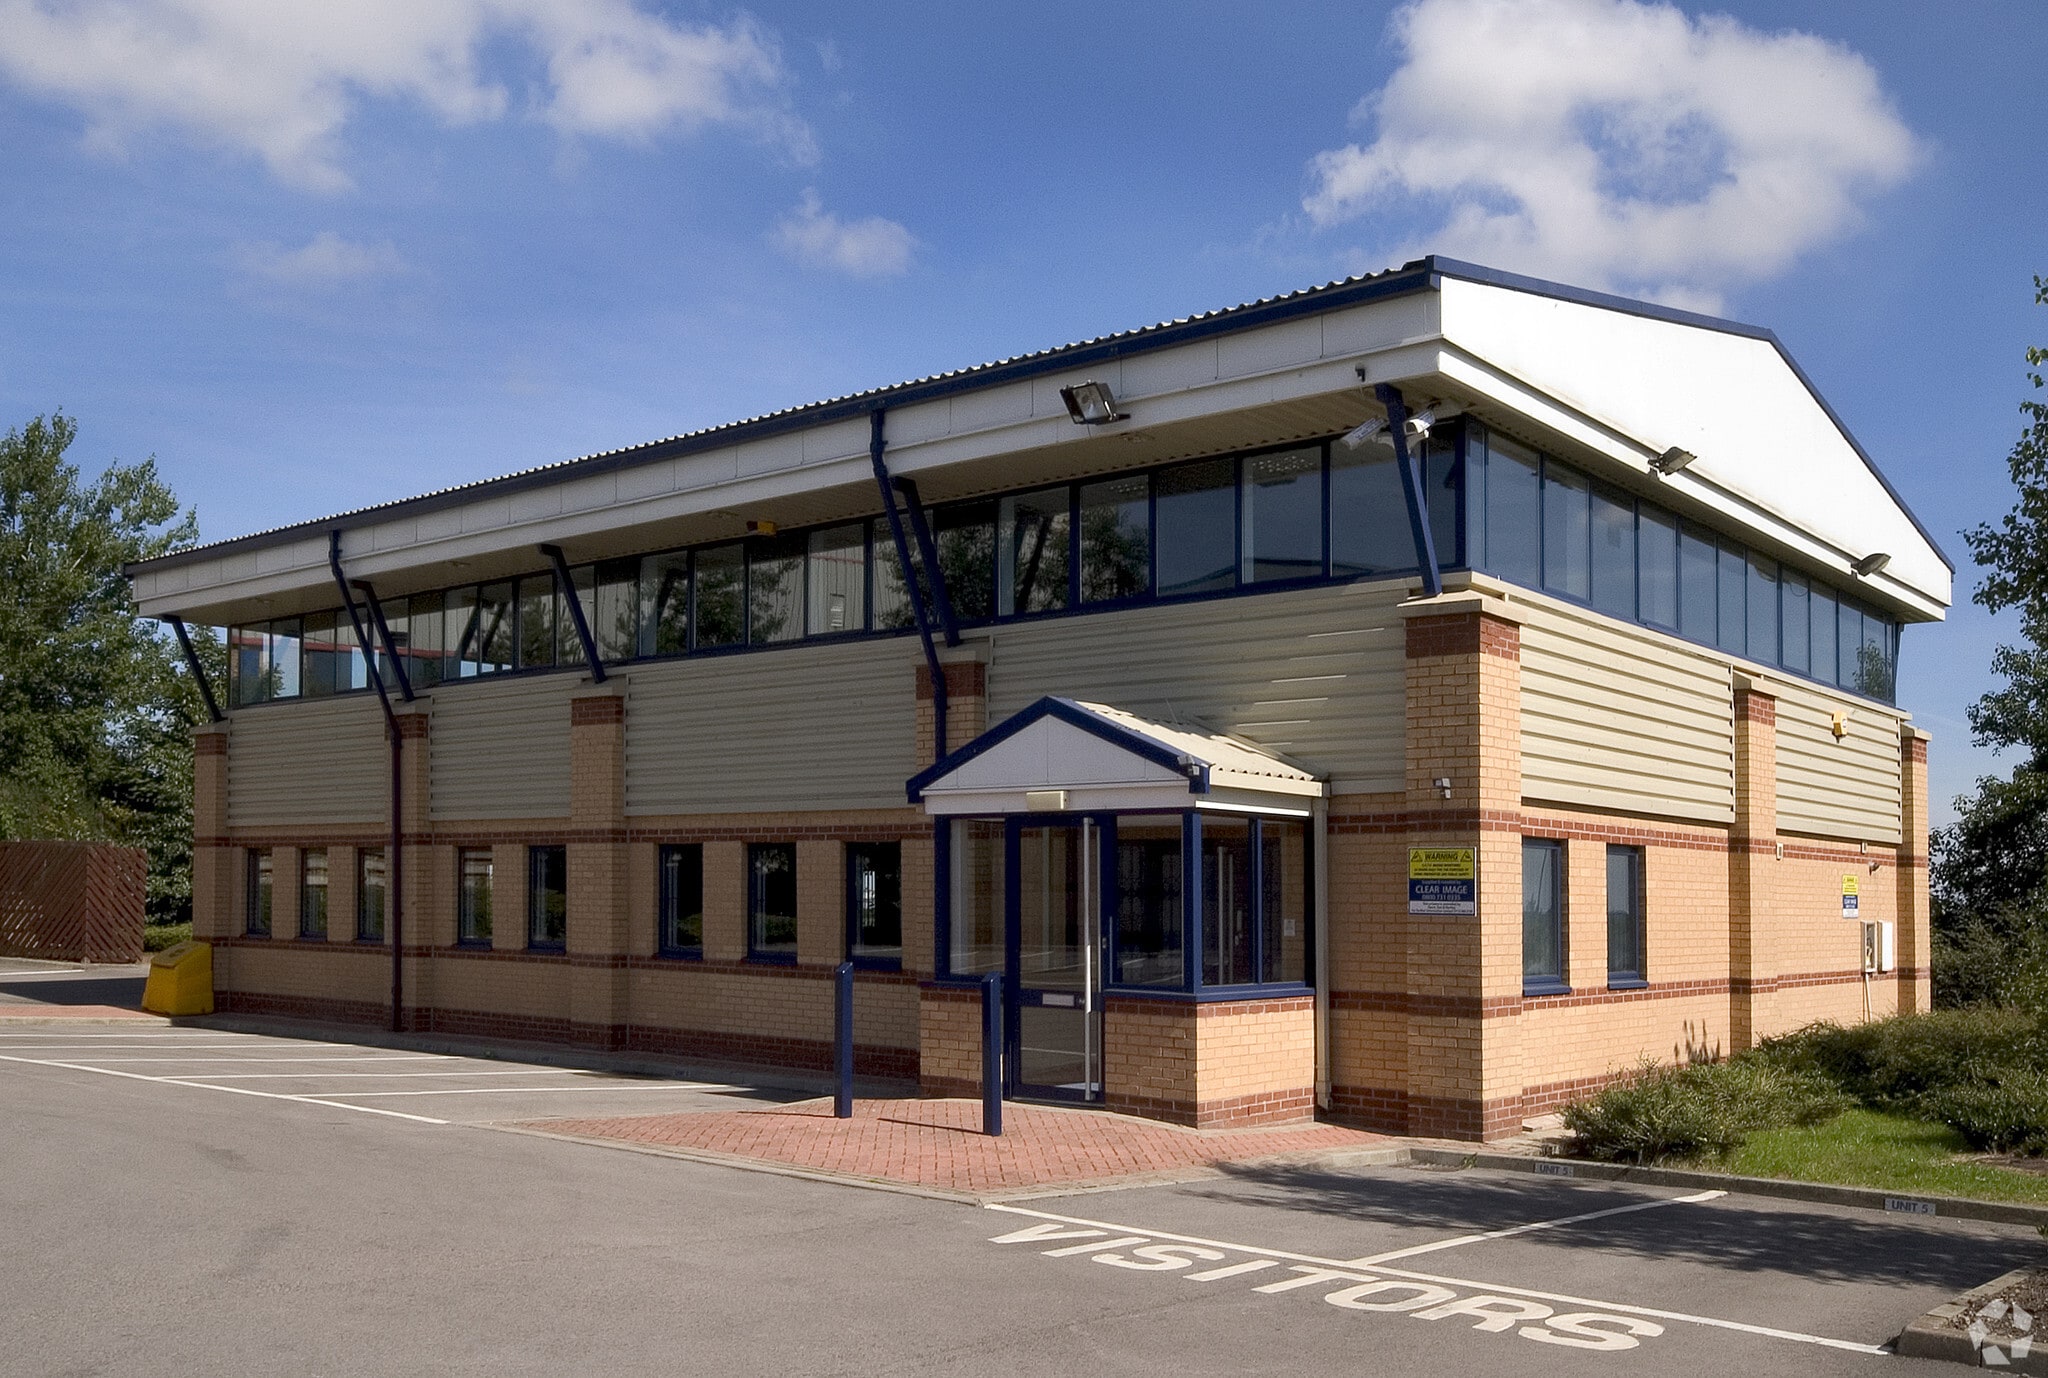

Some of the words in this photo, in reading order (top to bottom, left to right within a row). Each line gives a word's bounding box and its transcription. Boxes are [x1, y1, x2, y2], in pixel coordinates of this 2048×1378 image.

[1424, 852, 1458, 860] WARNING
[1415, 885, 1440, 894] CLEAR
[1442, 885, 1468, 894] IMAGE
[1539, 1164, 1561, 1175] UNIT
[1563, 1166, 1569, 1175] 5
[1891, 1199, 1918, 1212] UNIT
[1922, 1203, 1929, 1214] 5
[987, 1223, 1665, 1351] VISITORS
